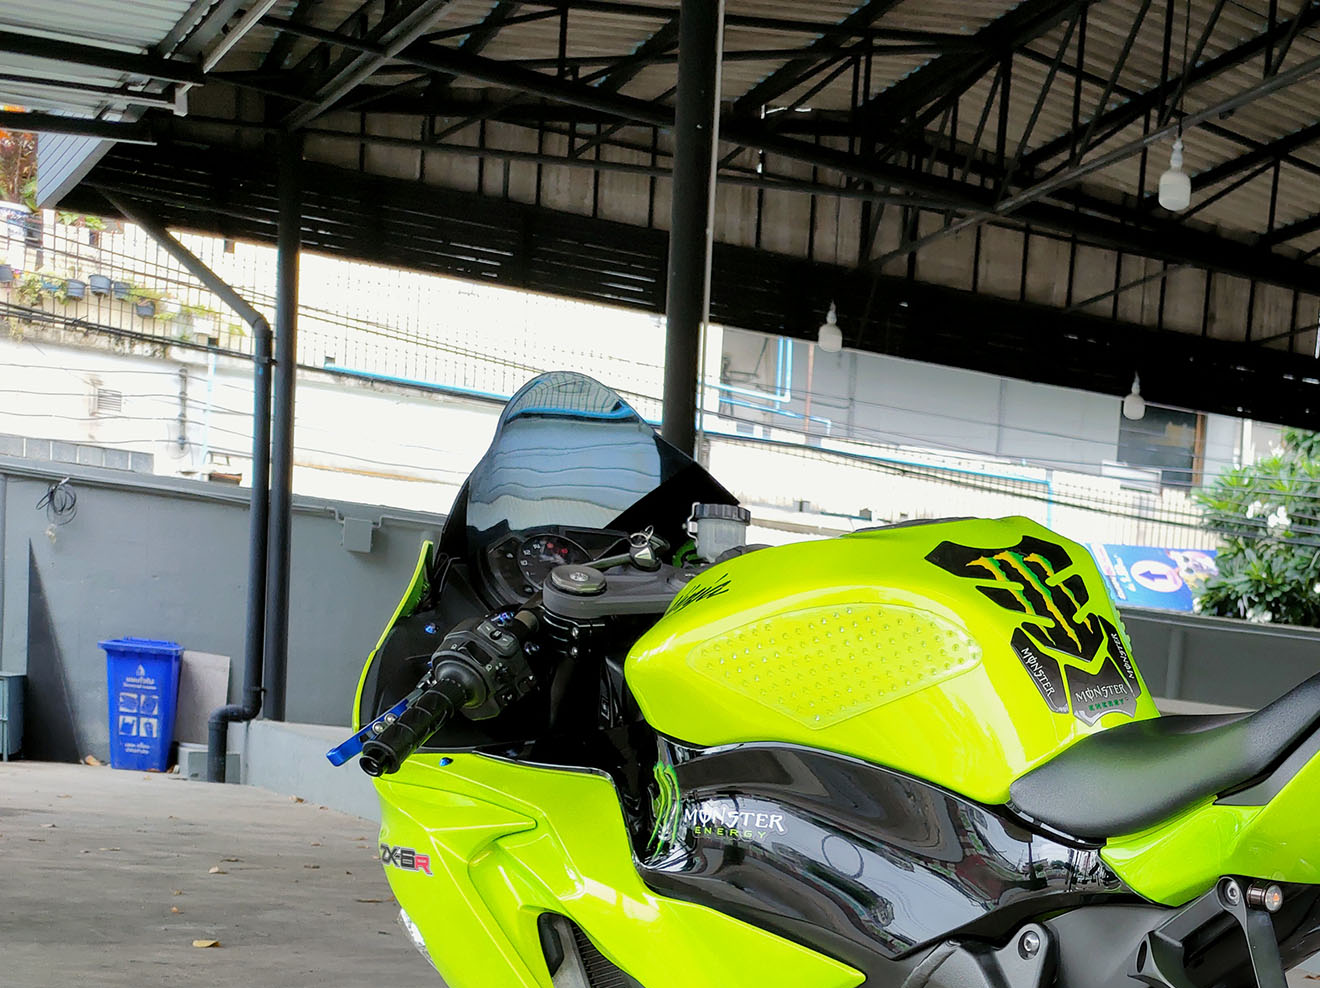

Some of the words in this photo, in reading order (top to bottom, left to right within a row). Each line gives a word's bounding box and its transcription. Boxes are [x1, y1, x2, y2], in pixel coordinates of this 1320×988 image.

[1021, 647, 1056, 697] MONSTER
[1075, 683, 1128, 703] MONSTER
[684, 806, 785, 832] MONSTER
[694, 826, 766, 839] ENERGY
